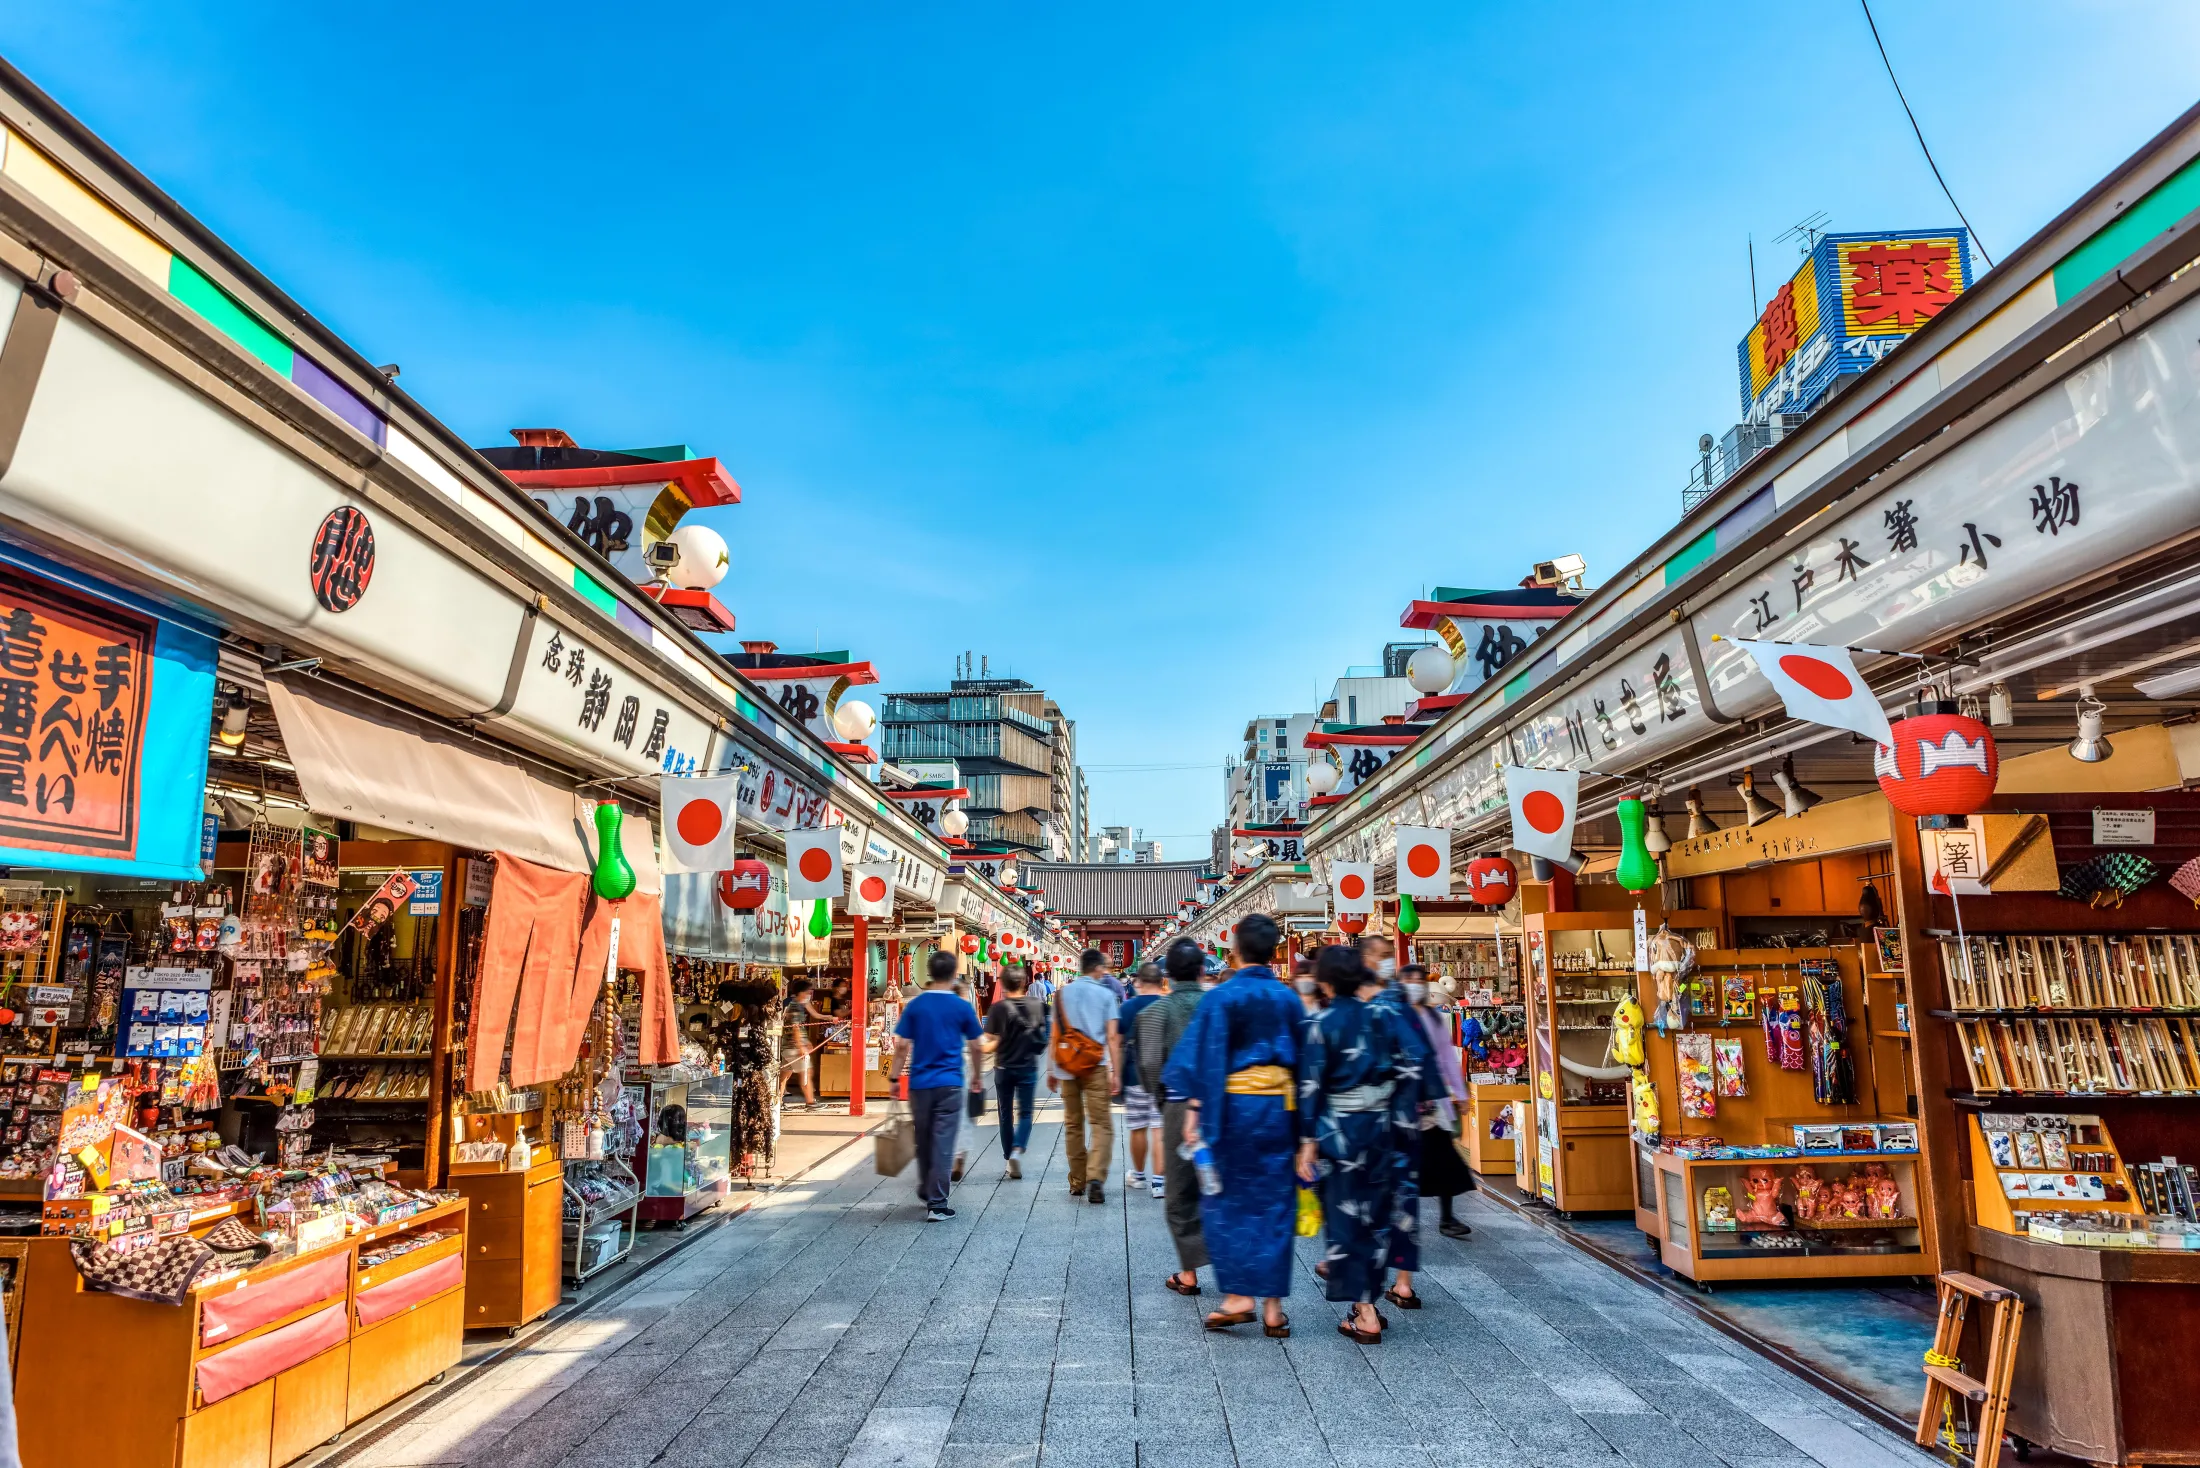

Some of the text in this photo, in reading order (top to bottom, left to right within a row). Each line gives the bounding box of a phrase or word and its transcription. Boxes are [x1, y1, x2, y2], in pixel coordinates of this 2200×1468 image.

[1761, 280, 1797, 376] 薬
[1848, 245, 1957, 325] 薬
[1843, 333, 1912, 357] マツモ
[1751, 476, 2080, 633] 江戸木箸 小物
[35, 649, 88, 814] せんべい
[84, 642, 131, 776] 手焼
[543, 630, 670, 763] 念珠 静岡屋
[1262, 838, 1307, 862] 仲見
[1942, 840, 1974, 876] 箸
